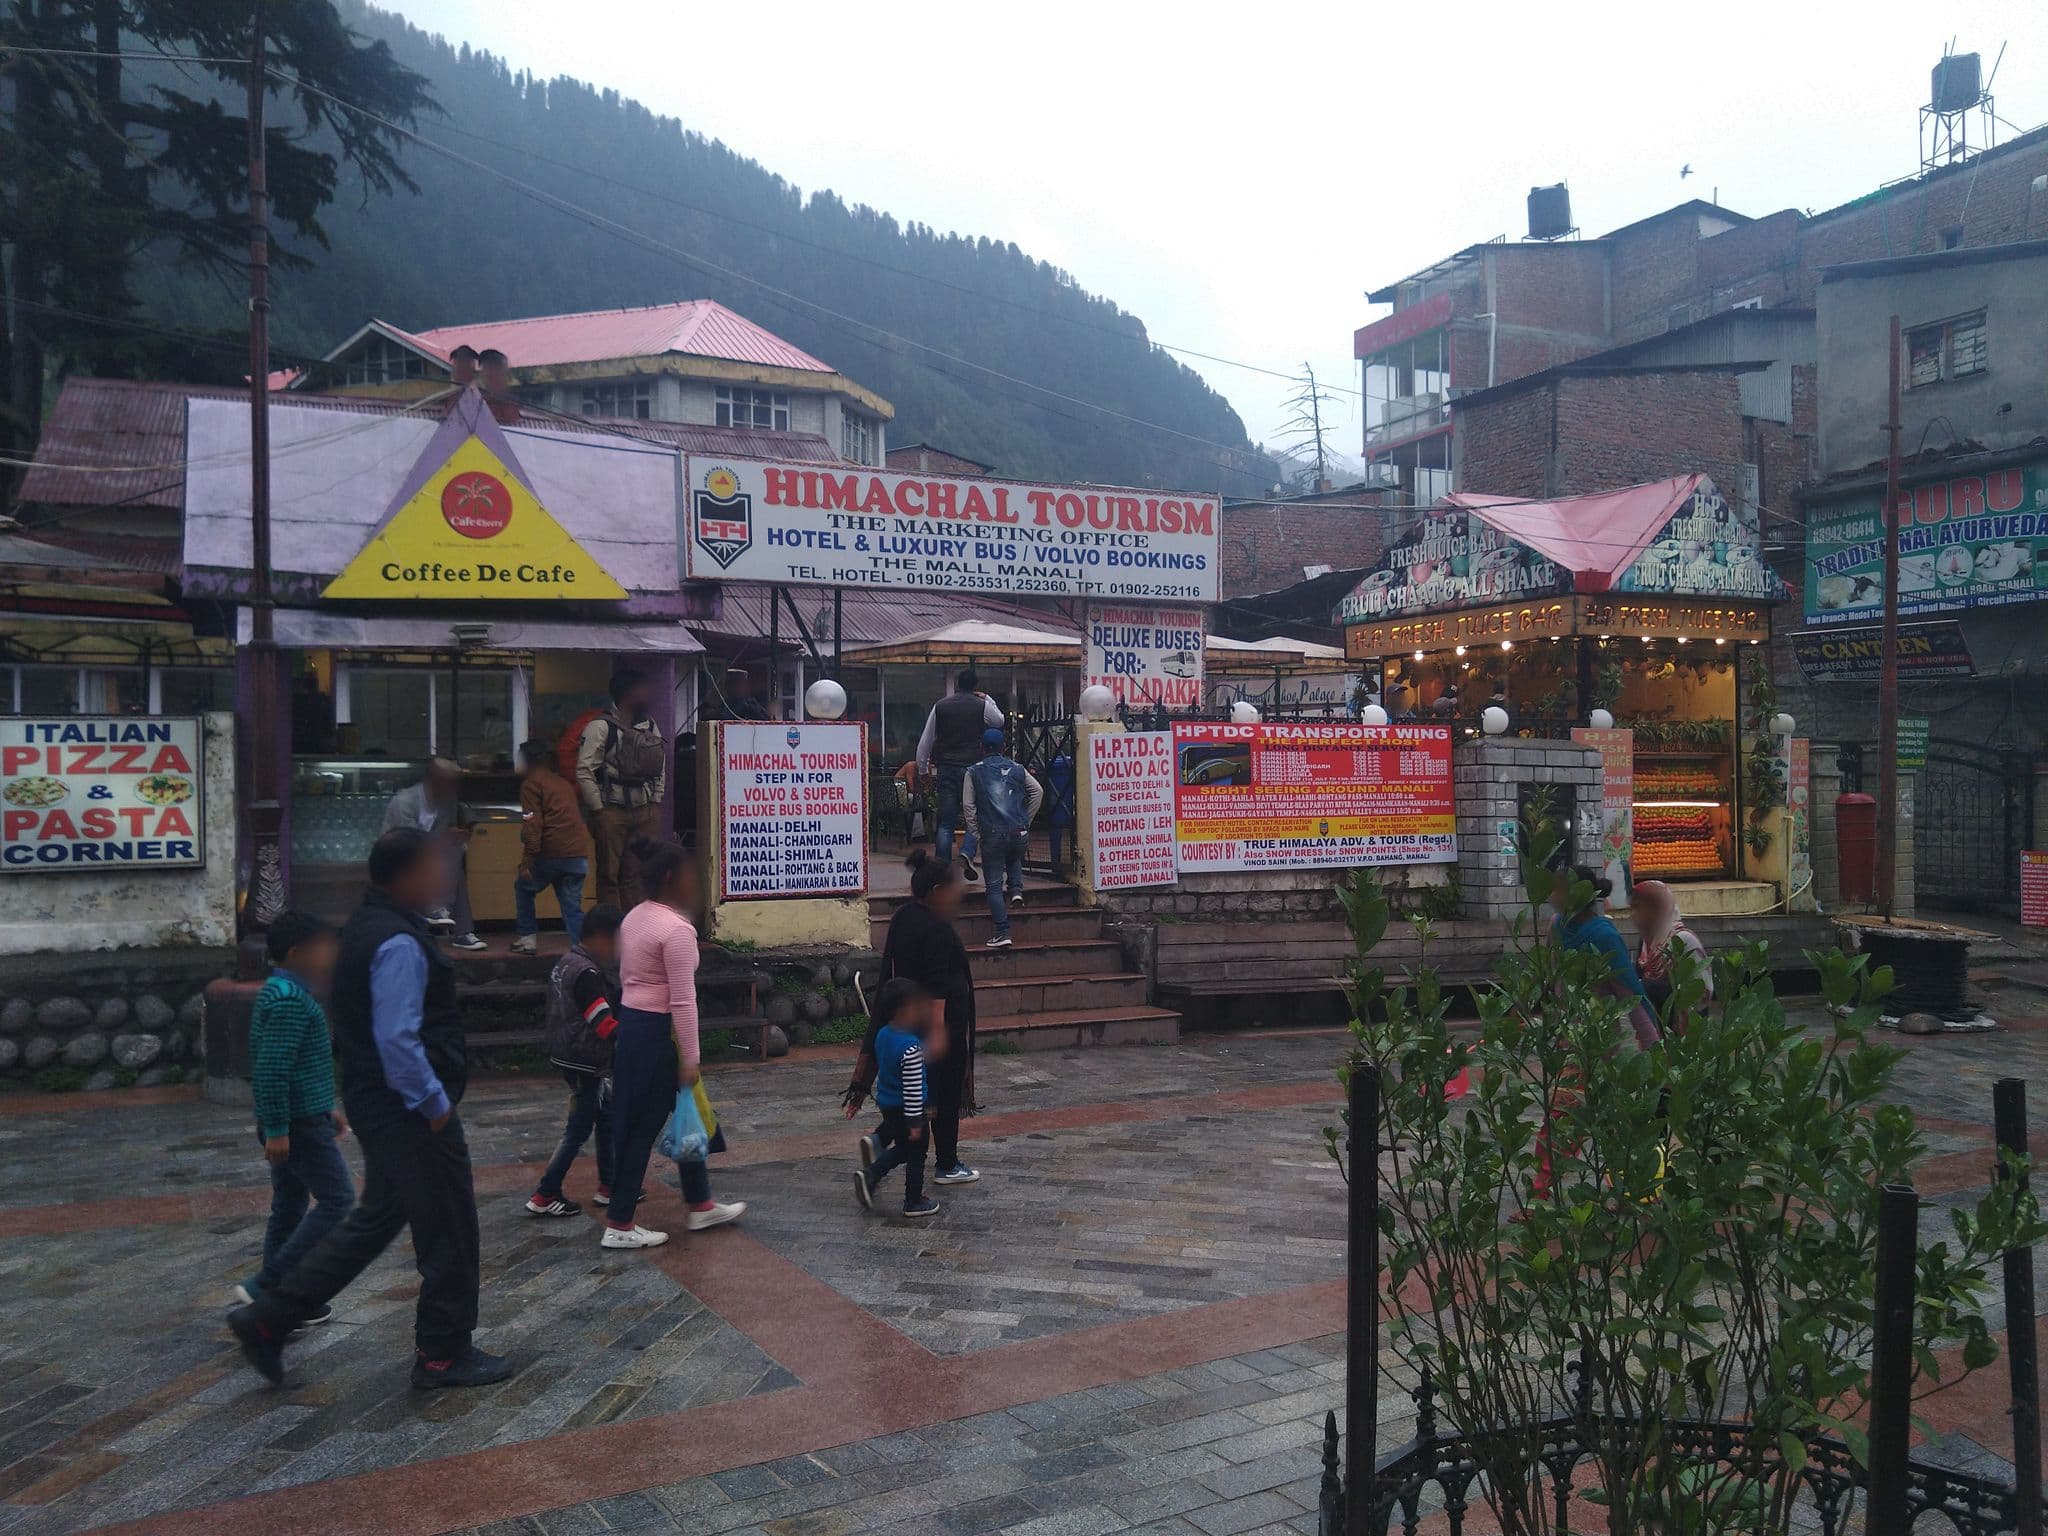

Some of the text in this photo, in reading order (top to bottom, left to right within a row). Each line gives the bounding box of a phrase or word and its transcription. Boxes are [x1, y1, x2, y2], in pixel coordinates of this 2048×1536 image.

[762, 467, 1215, 535] HIMACHAL TOURISM
[1693, 494, 1724, 519] H.P.
[827, 513, 1149, 548] THE MARKETING OFFICE
[1423, 512, 1462, 542] H.P.
[1672, 518, 1699, 541] FRESH
[1699, 520, 1724, 543] JUICE
[767, 528, 1207, 570] HOTEL & LUXURY BUS VOLVO BOOKINGS
[1389, 530, 1497, 569] FRESH JUICE BAR
[1812, 525, 1936, 579] TRADITINAL
[381, 563, 576, 583] Coffee De Cafe
[868, 556, 1084, 579] THE MALL MANALI
[1437, 561, 1448, 576] &
[788, 565, 827, 579] TEL.
[832, 568, 892, 583] HOTEL
[1075, 581, 1105, 594] TPT.
[1110, 584, 1201, 597] 01902-252116
[1634, 562, 1772, 593] FRUIT CHAAT ALL SHAKE
[1341, 562, 1557, 618] FRUIT CHAAT & ALL SHAKE
[1945, 577, 2035, 598] MALL MANALI
[1103, 608, 1201, 627] HIMACHAL TOURISM
[1389, 604, 1563, 648] FRESH JUICE BAR
[1619, 606, 1762, 631] FRESH JUICE BAR
[1093, 626, 1201, 650] DELUXE BUSES
[1821, 636, 1933, 660] CANTEN
[1129, 677, 1200, 704] LADAKH
[1300, 679, 1336, 702] Palace
[25, 723, 171, 743] ITALIAN
[1176, 725, 1448, 740] HPTDC TRANSPORT WING
[1584, 732, 1623, 742] H.P.
[1094, 736, 1170, 759] H.P.T.D.C.
[1257, 737, 1423, 746] THE PERFECT HOST
[1265, 744, 1418, 752] LONG DISTANCE SERVICE
[2, 745, 193, 776] PIZZA
[729, 753, 858, 770] HIMACHAL TOURISM
[1095, 759, 1170, 779] VOLVO A/C
[1604, 755, 1632, 767] JUICE
[755, 773, 833, 784] STEP IN FOR
[1096, 780, 1170, 792] COACHES TO DELHI &
[1603, 775, 1633, 785] CHAAT
[87, 784, 114, 800] &
[743, 787, 844, 801] VOLVO & SUPER
[1109, 791, 1161, 802] SPECIAL
[1200, 784, 1434, 795] SIGHT SEEING AROUND MANALI
[730, 803, 859, 817] DELUXE BUS BOOKING
[1097, 803, 1171, 816] SUPER DELUXE BUSES TO
[3, 807, 194, 841] PASTA
[730, 821, 821, 834] MANALI-DELHI
[1098, 816, 1172, 833] ROHTANG LEH
[730, 834, 853, 849] MANALI-CHANDIGARH
[1098, 833, 1172, 848] MANIKARAN, SHIMLA
[1243, 834, 1453, 849] TRUE HIMALAYA ADV. & TOURS (Regd.)
[3, 840, 196, 864] CORNER
[730, 849, 834, 863] MANALI-SHIMLA
[1099, 847, 1173, 862] & OTHER LOCAL
[1182, 842, 1237, 861] COURTESY BY
[1244, 844, 1454, 859] Also SNOW DRESS for SNOW POINTS (Shop No. 131)
[1244, 859, 1267, 867] VINOD
[1268, 858, 1288, 866] SAINI
[1288, 857, 1307, 866] (Mob.
[1406, 853, 1430, 861] MANALI
[730, 861, 859, 877] MANALI-ROHTANG & BACK
[1100, 861, 1161, 875] SIGHT SEEING TOURS
[730, 875, 859, 892] MANALI-MANIKARAN & BACK
[1101, 871, 1174, 887] AROUND MANALI
